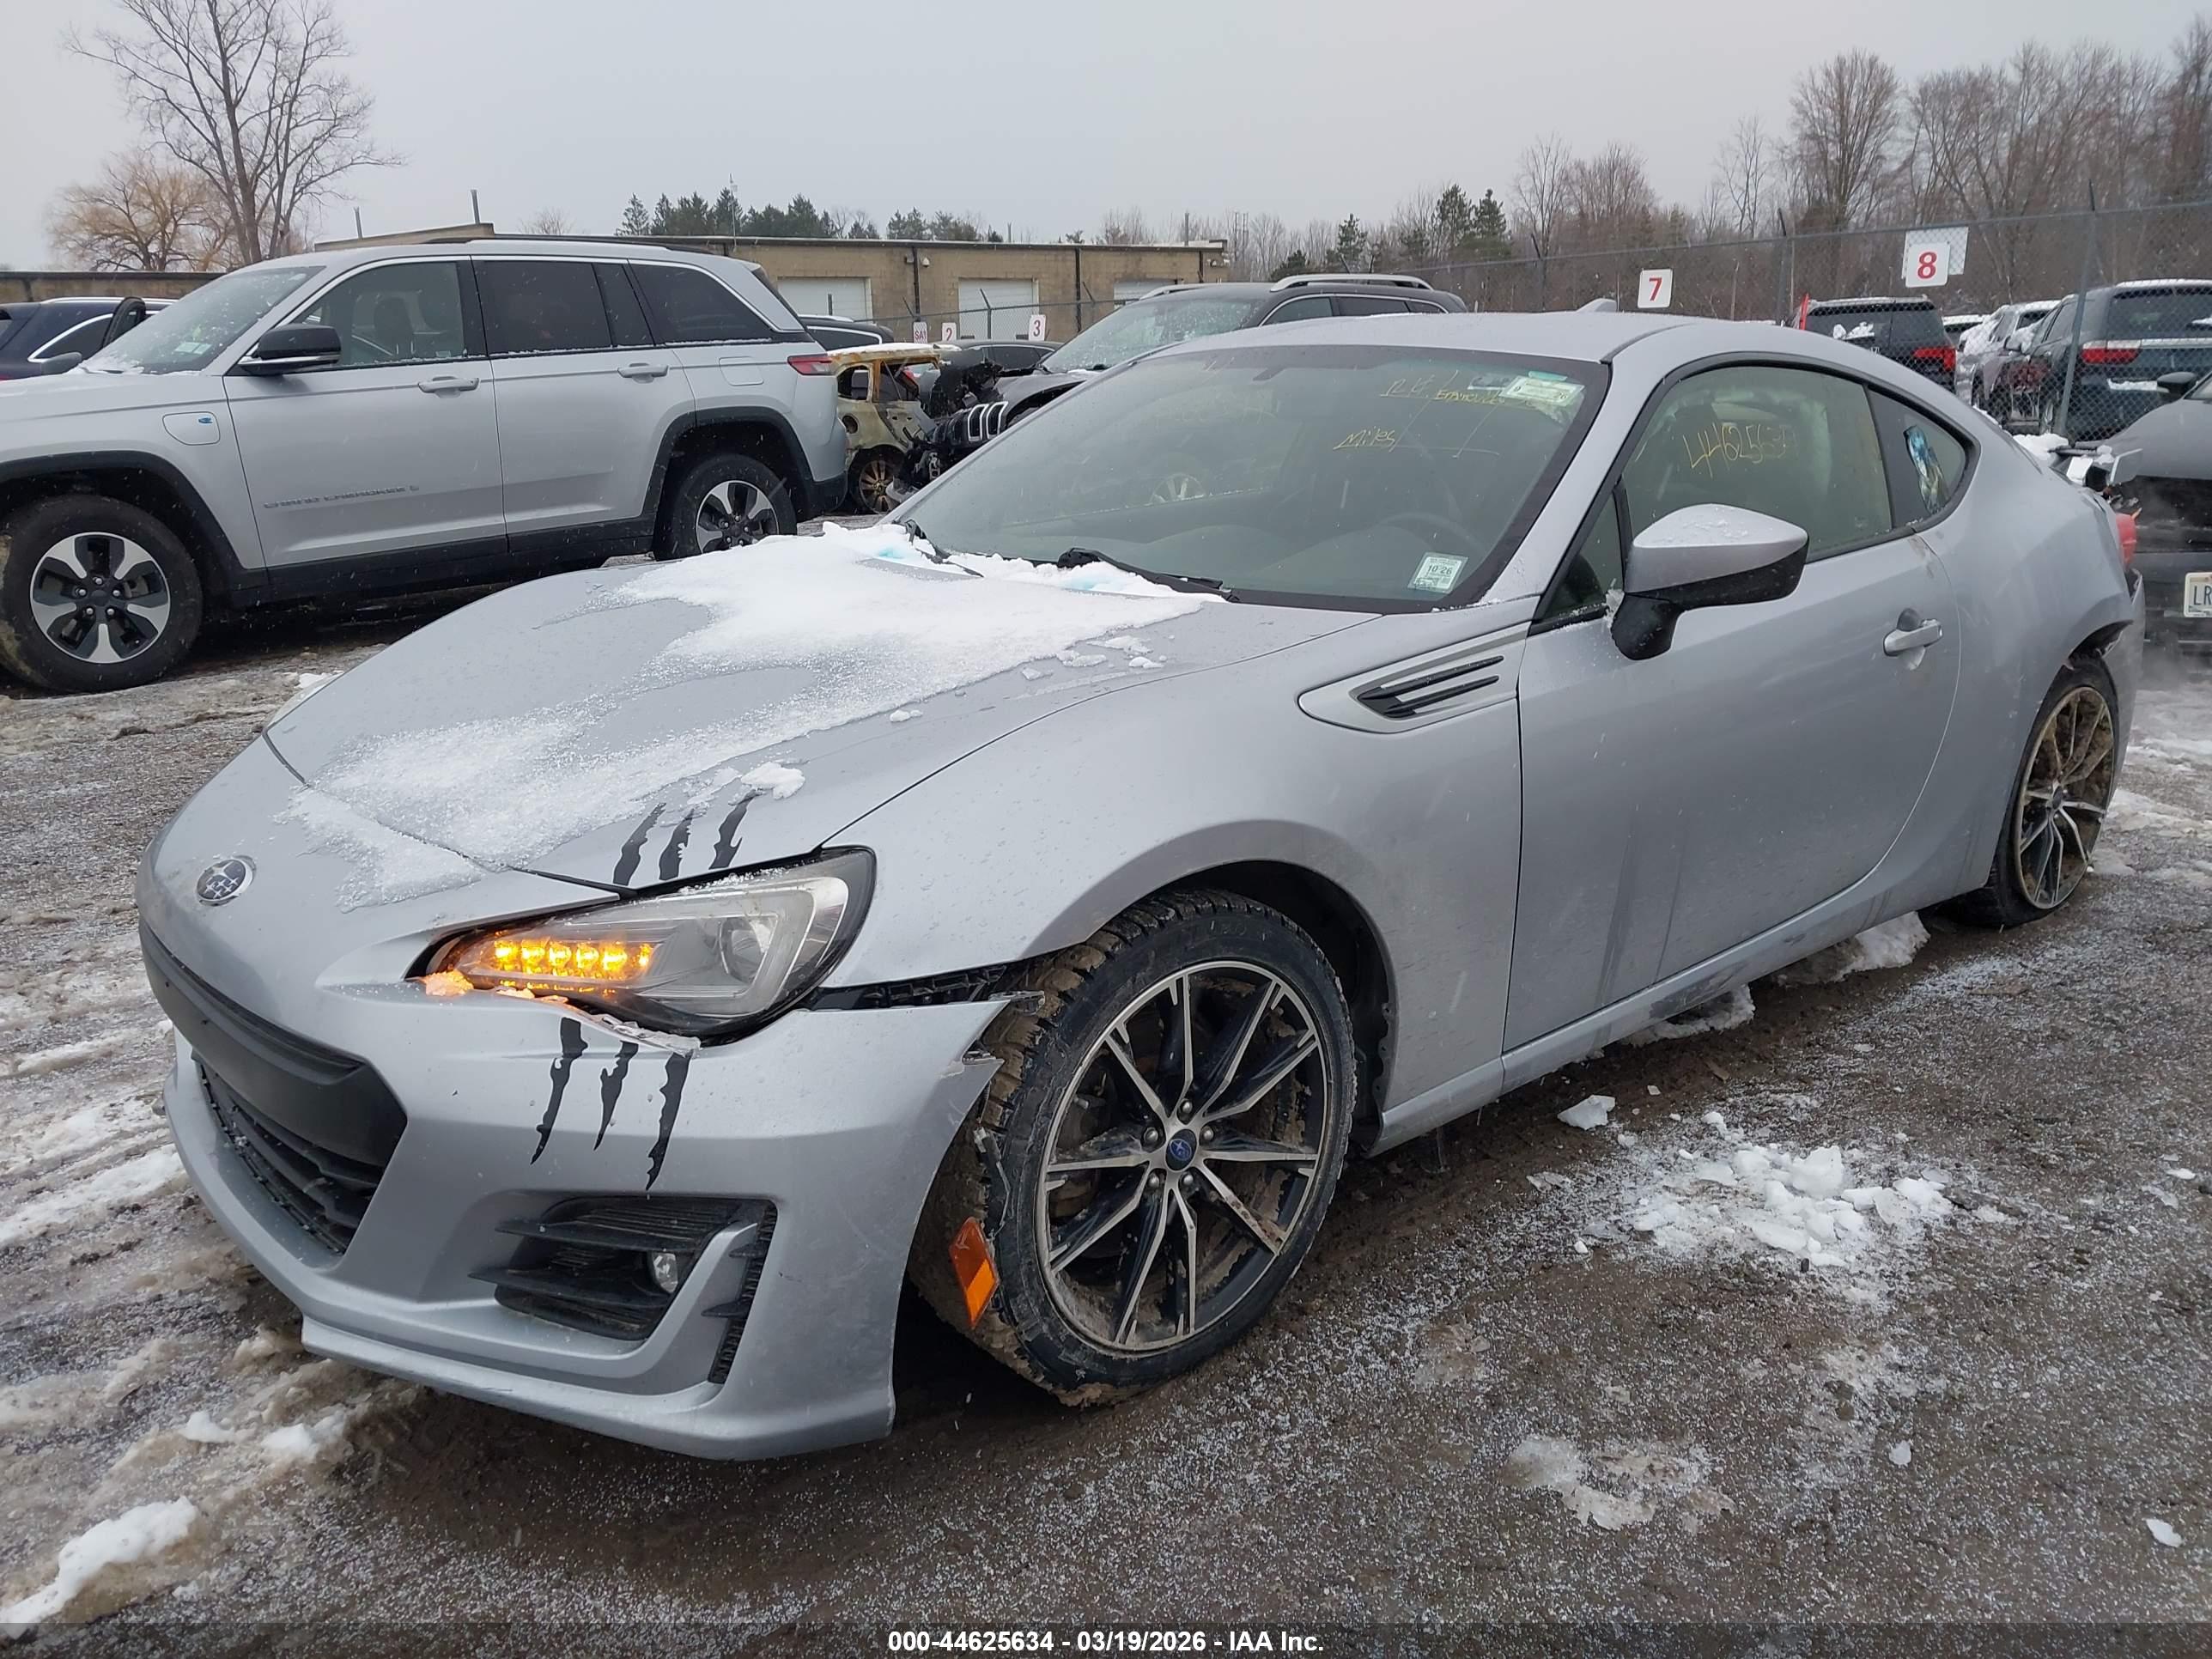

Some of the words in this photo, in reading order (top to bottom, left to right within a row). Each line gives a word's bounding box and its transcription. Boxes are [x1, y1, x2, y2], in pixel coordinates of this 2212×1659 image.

[1917, 252, 1937, 280] 8
[1649, 276, 1662, 301] 7
[945, 327, 952, 342] 2
[1033, 320, 1041, 337] 3
[1427, 564, 1438, 573] 10
[2193, 586, 2212, 605] LR
